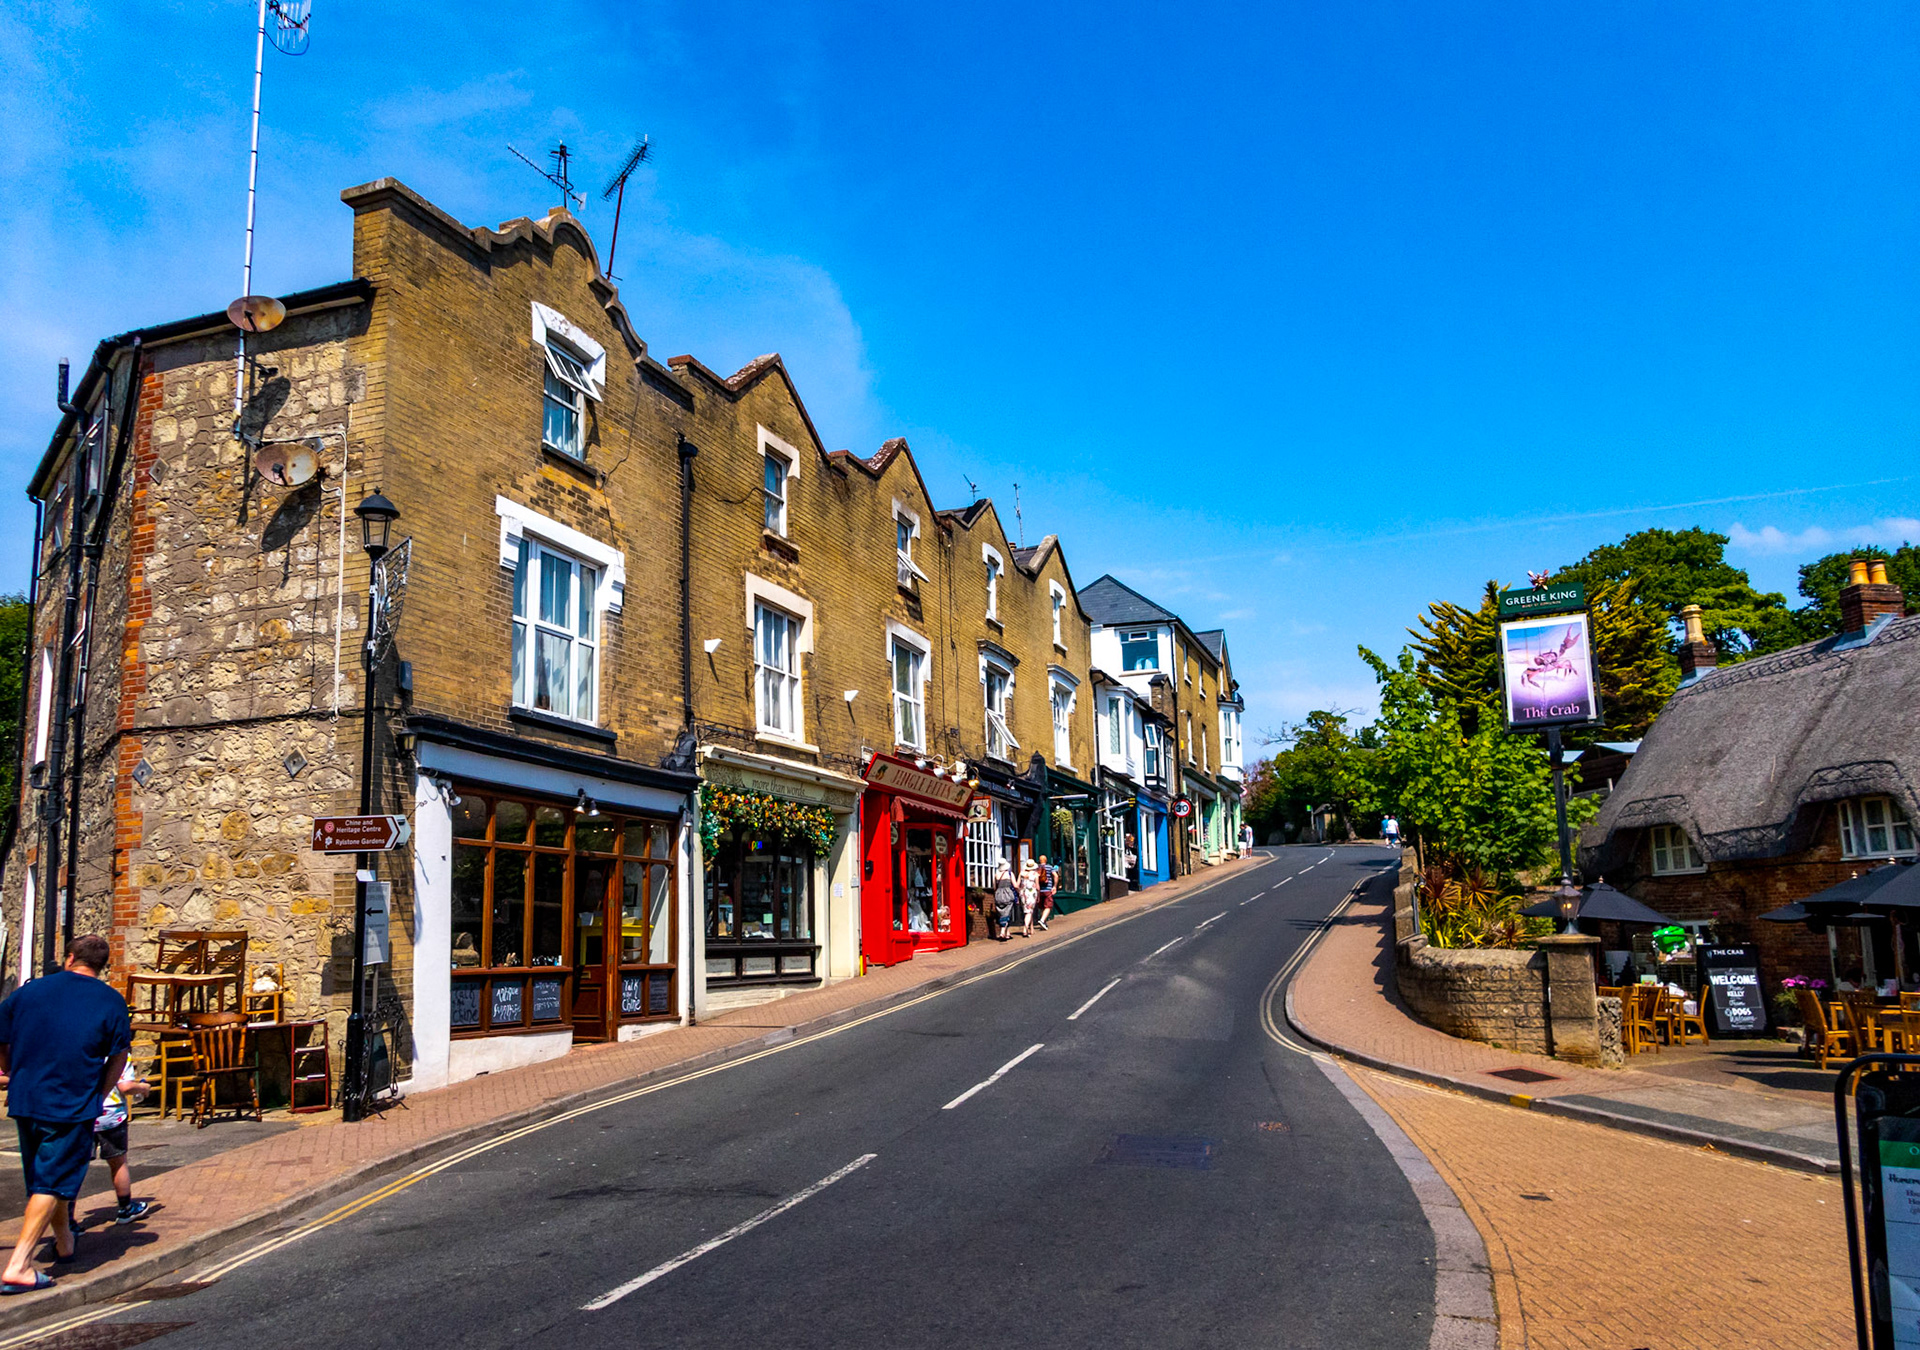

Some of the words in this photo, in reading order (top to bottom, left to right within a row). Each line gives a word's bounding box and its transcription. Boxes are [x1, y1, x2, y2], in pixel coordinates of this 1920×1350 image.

[1505, 594, 1546, 606] GREENE
[1550, 590, 1577, 601] KING
[1523, 707, 1547, 719] The
[1550, 703, 1580, 716] Crab
[752, 780, 769, 791] more
[770, 777, 785, 793] than
[786, 782, 805, 796] words
[891, 769, 925, 791] JINGLE
[925, 780, 953, 799] BELLS
[1175, 804, 1189, 813] 30
[1710, 975, 1758, 985] WELCOME
[1732, 1008, 1752, 1016] DOGS
